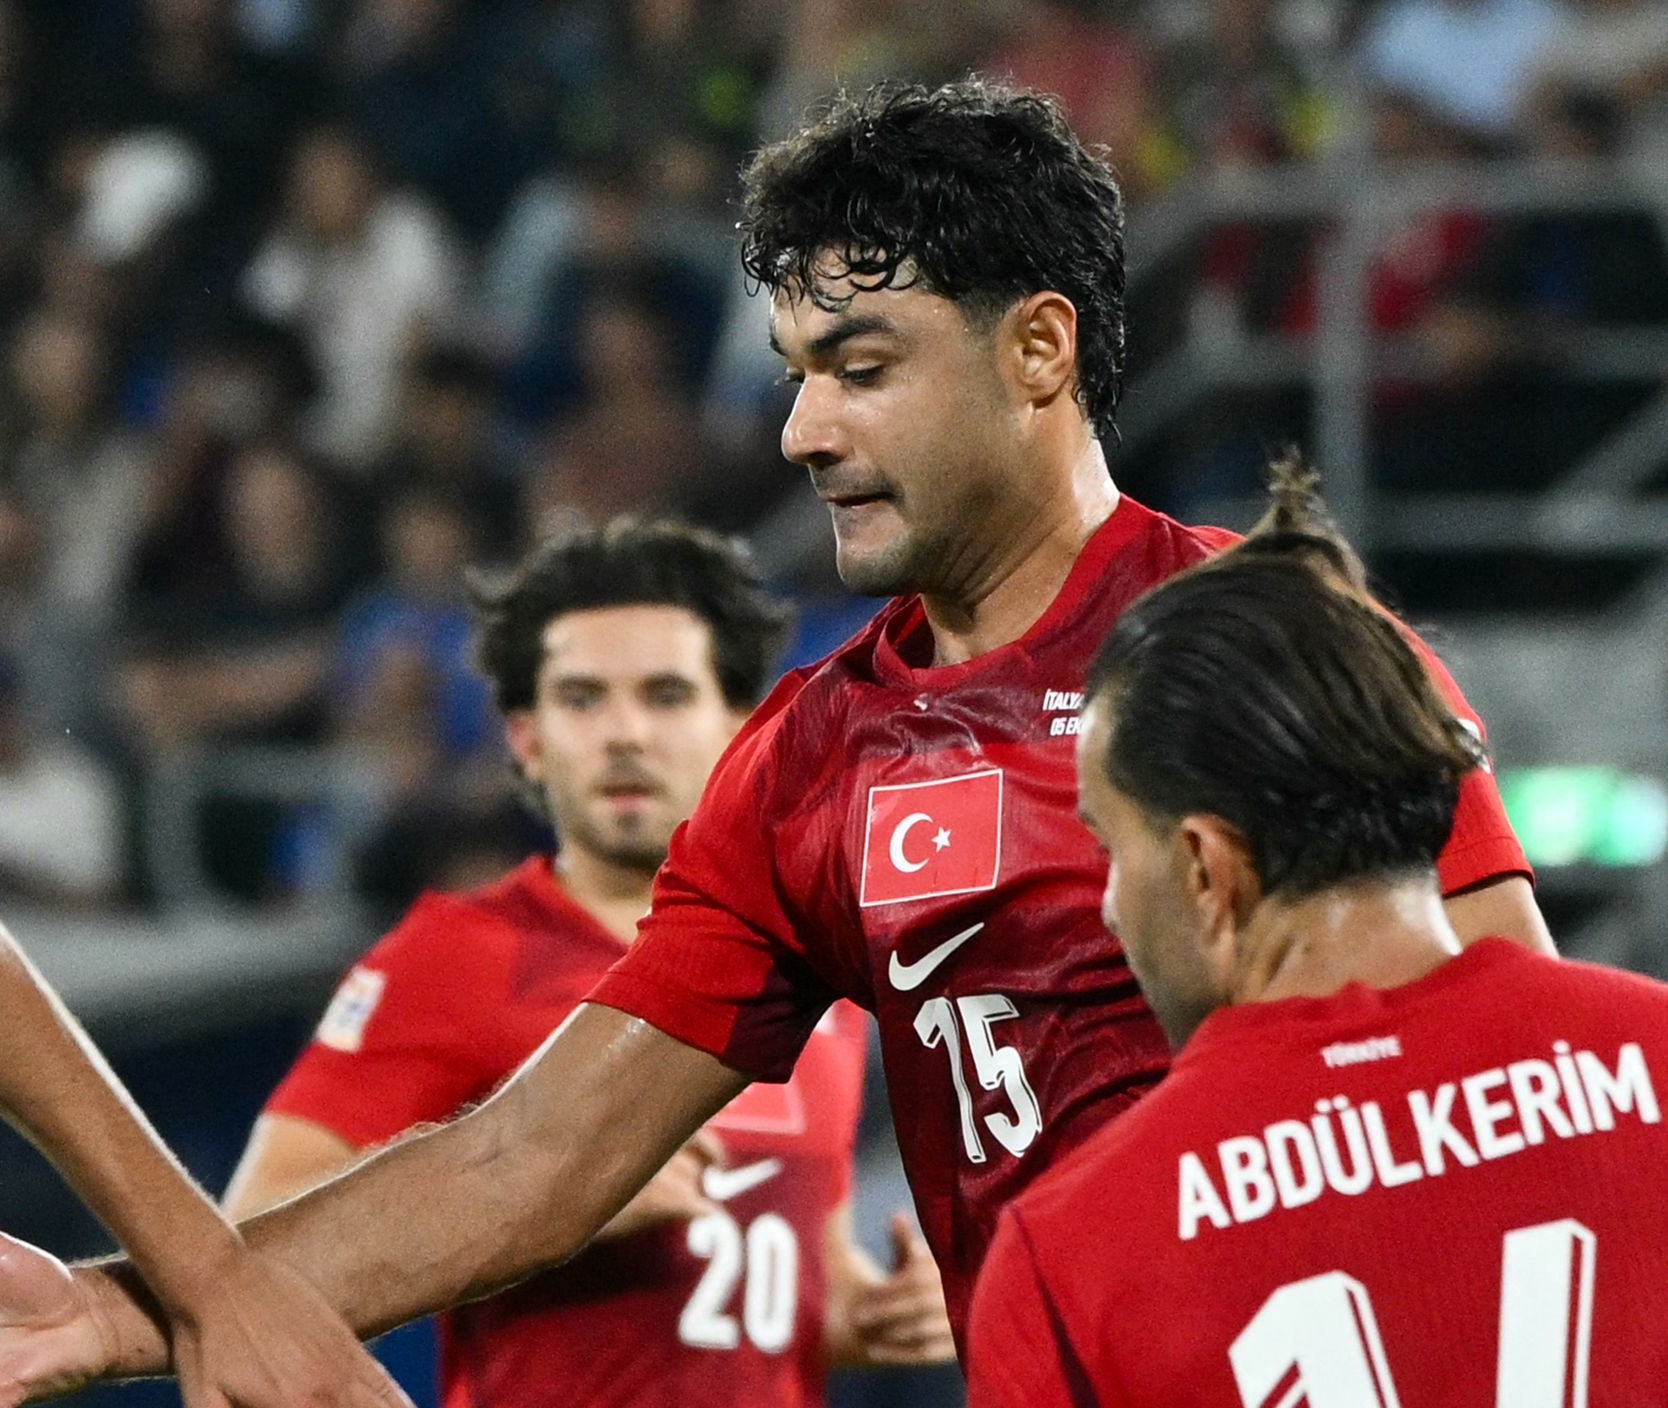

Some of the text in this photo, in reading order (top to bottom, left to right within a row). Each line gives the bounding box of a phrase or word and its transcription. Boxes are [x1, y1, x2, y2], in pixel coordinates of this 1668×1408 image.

[912, 994, 1043, 1164] 15
[1179, 1040, 1661, 1240] ABDÜLKERİM
[677, 1212, 800, 1354] 20
